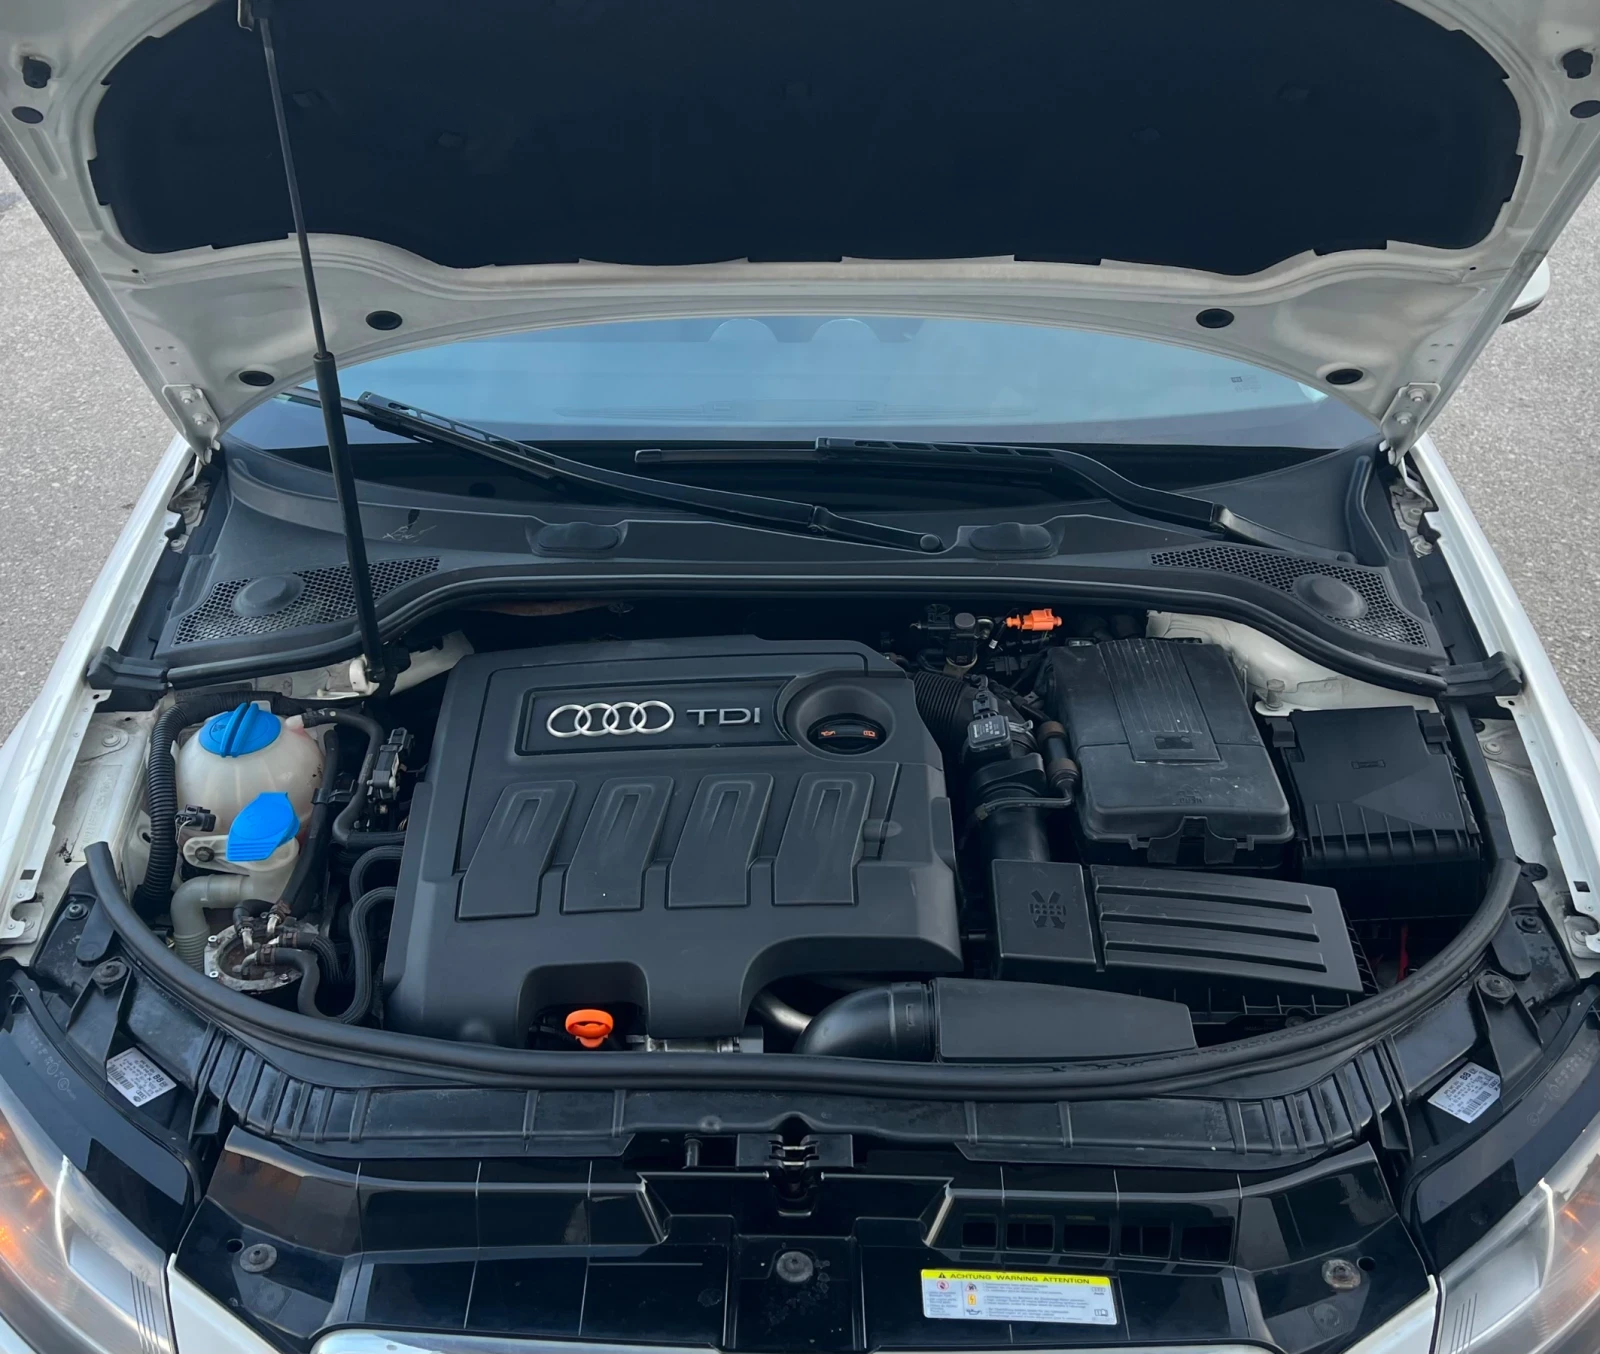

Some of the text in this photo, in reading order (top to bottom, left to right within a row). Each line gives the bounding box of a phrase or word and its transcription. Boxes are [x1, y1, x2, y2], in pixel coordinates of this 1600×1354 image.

[686, 707, 761, 726] TDI
[996, 1274, 1038, 1282] WARNING
[1043, 1276, 1090, 1285] ATTENTION
